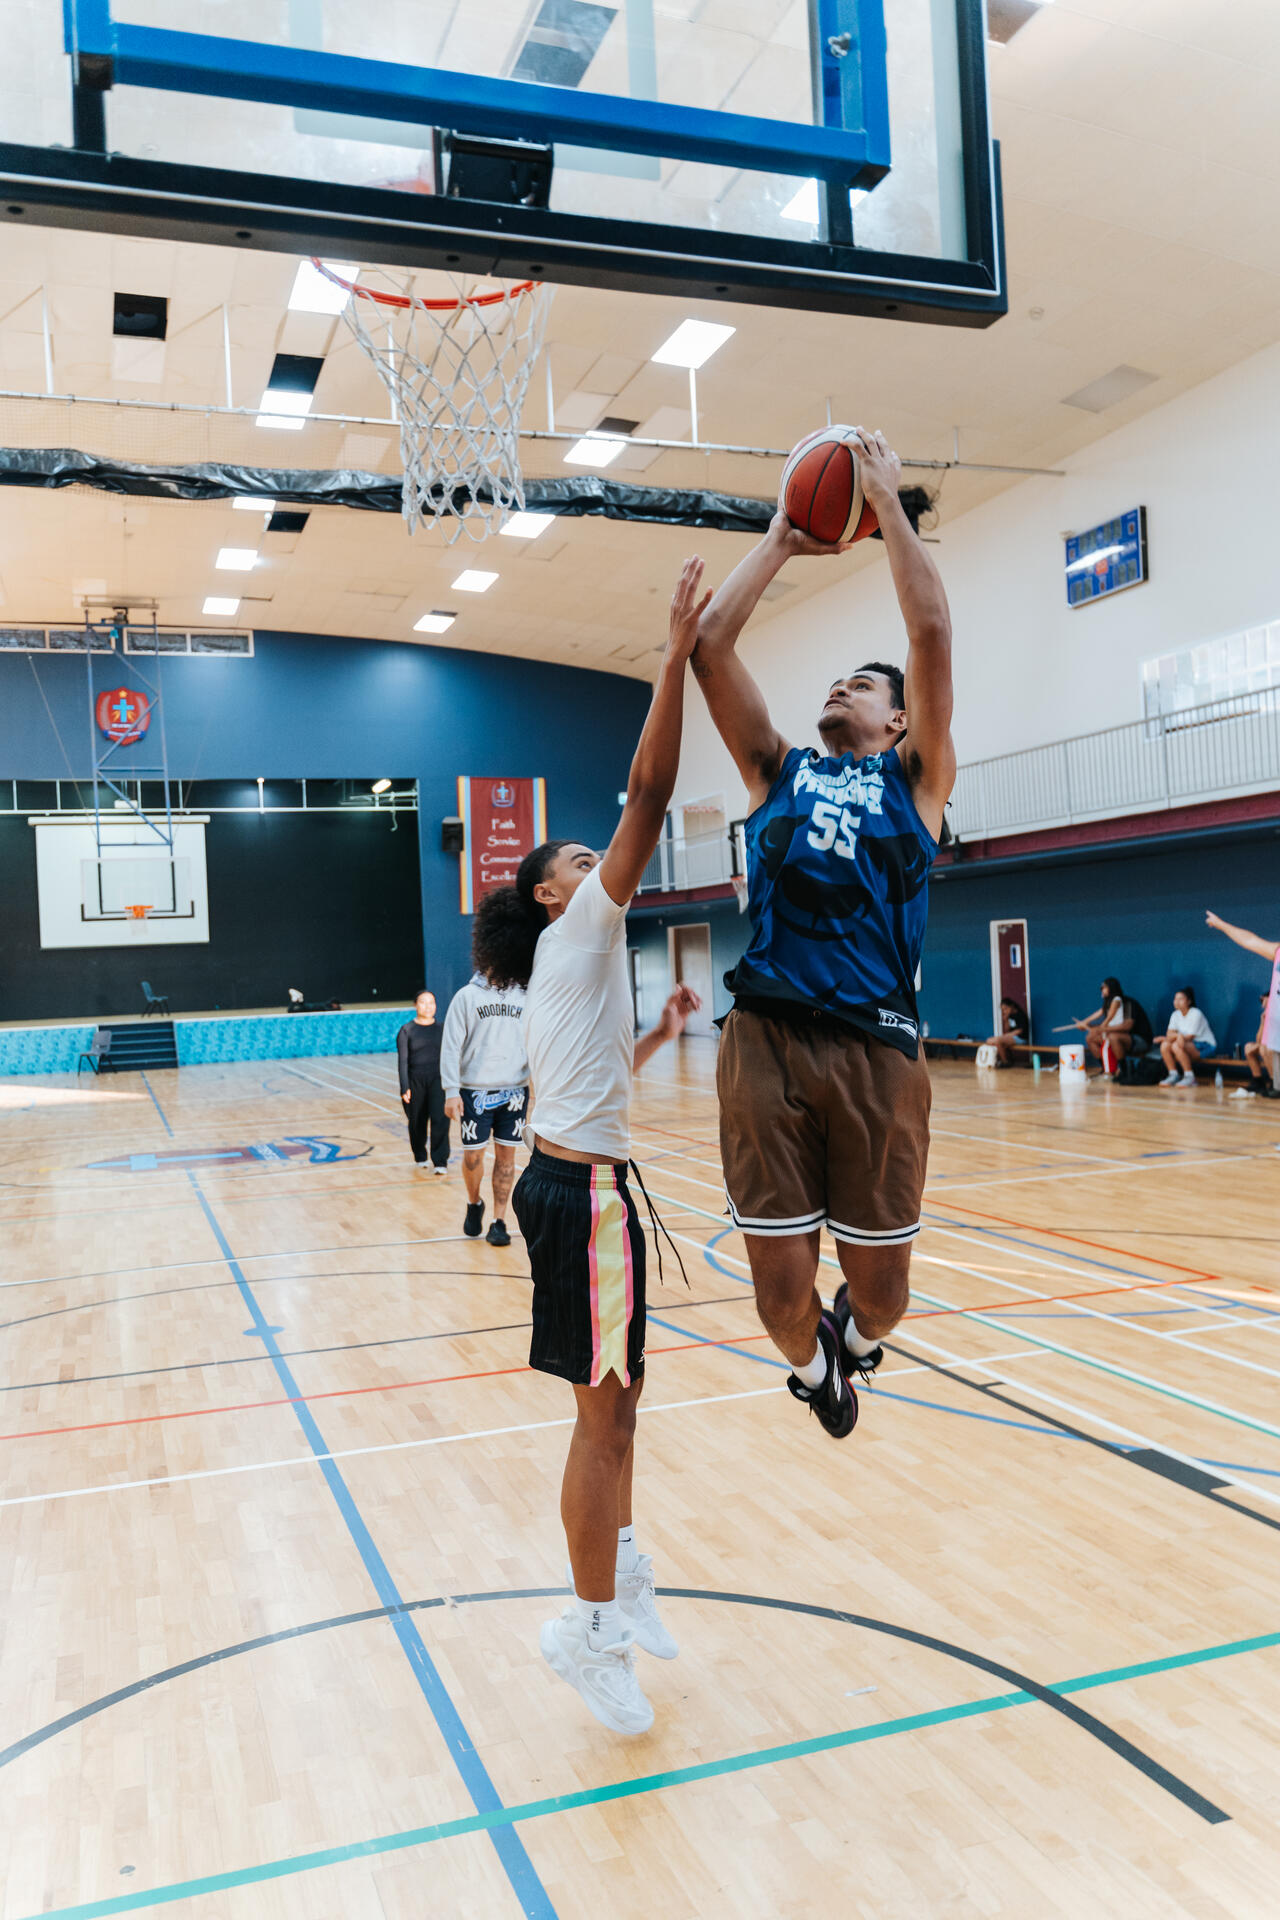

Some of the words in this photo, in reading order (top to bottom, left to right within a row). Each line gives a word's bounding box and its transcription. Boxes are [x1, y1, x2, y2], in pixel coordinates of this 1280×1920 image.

[491, 818, 516, 831] Faith
[807, 800, 861, 860] 55
[486, 835, 521, 847] Service
[480, 852, 524, 864] Communit
[476, 1003, 523, 1020] HOODRICH
[461, 1119, 478, 1140] NY
